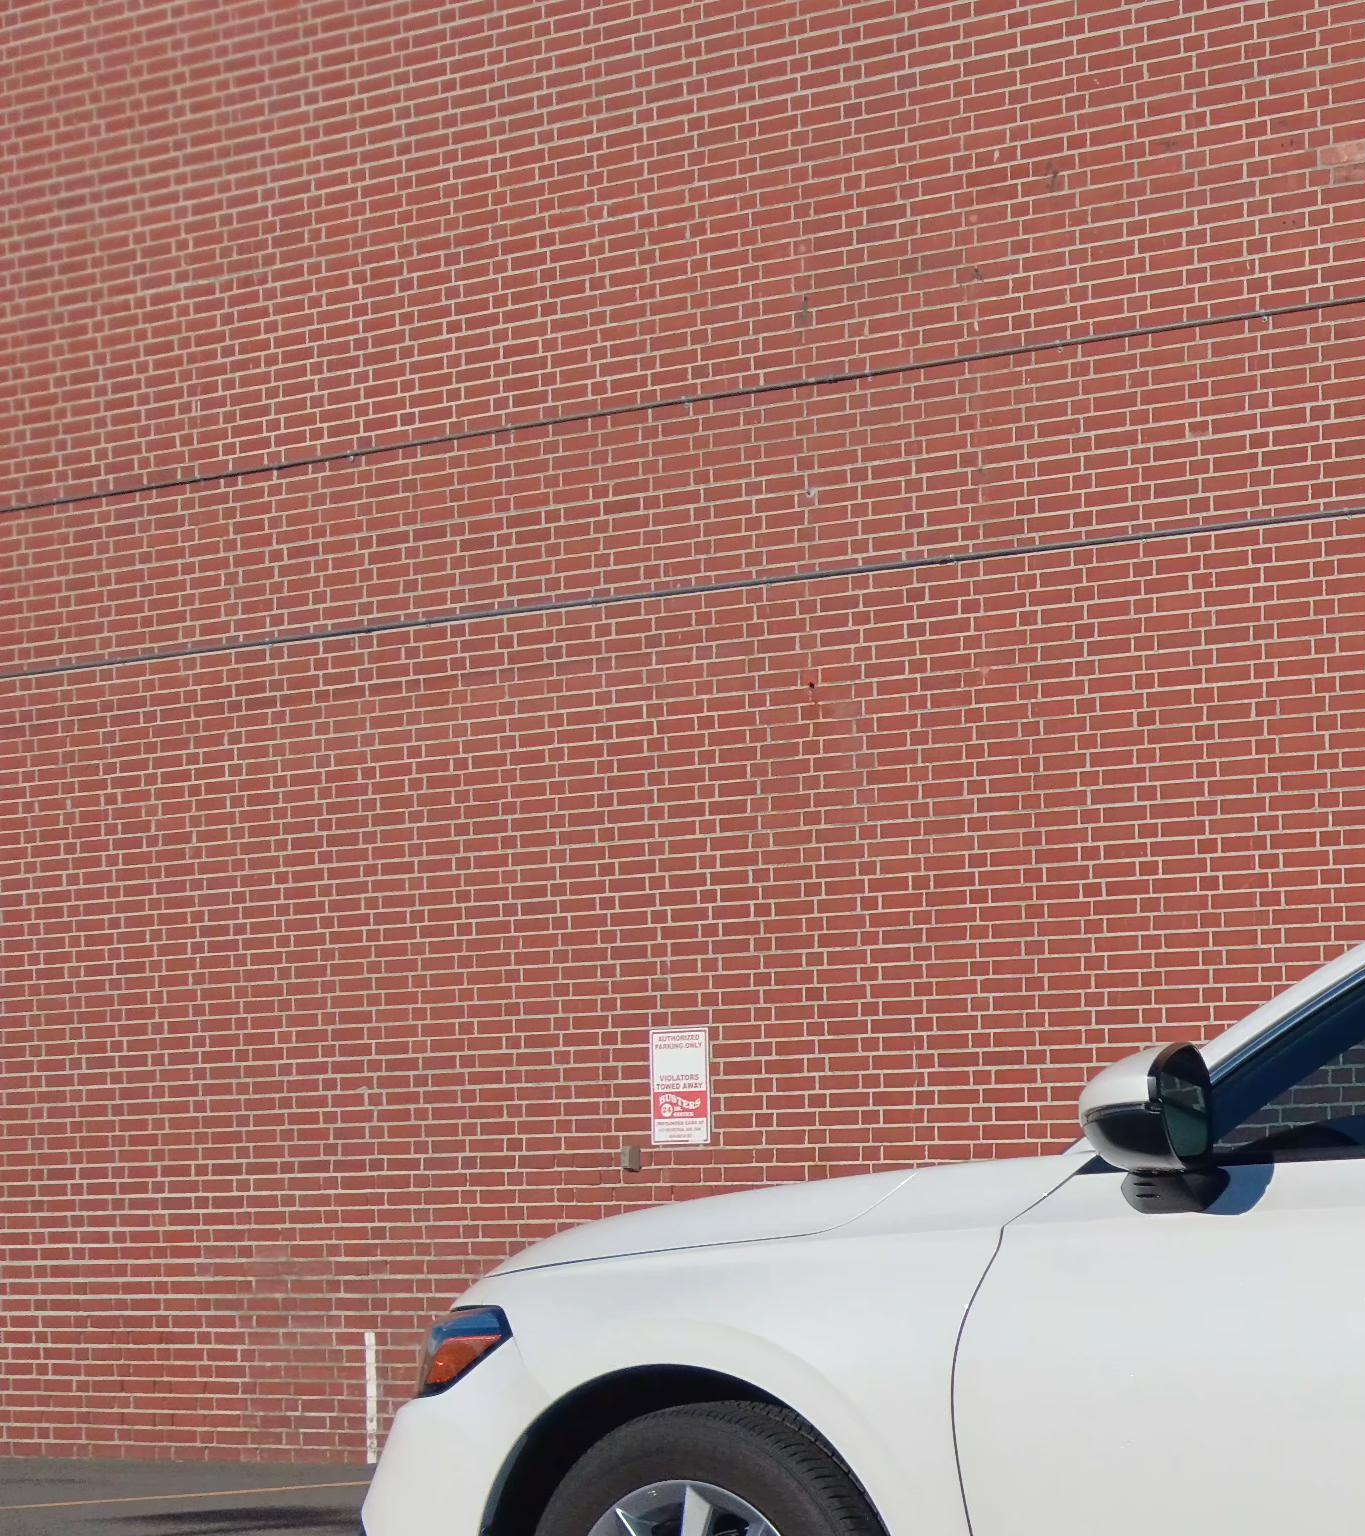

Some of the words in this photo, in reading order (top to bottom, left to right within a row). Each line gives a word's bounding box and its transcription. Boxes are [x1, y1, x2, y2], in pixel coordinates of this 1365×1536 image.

[654, 1042, 684, 1050] PARKING
[659, 1073, 700, 1082] VIOLATORS
[656, 1083, 681, 1091] TOWED
